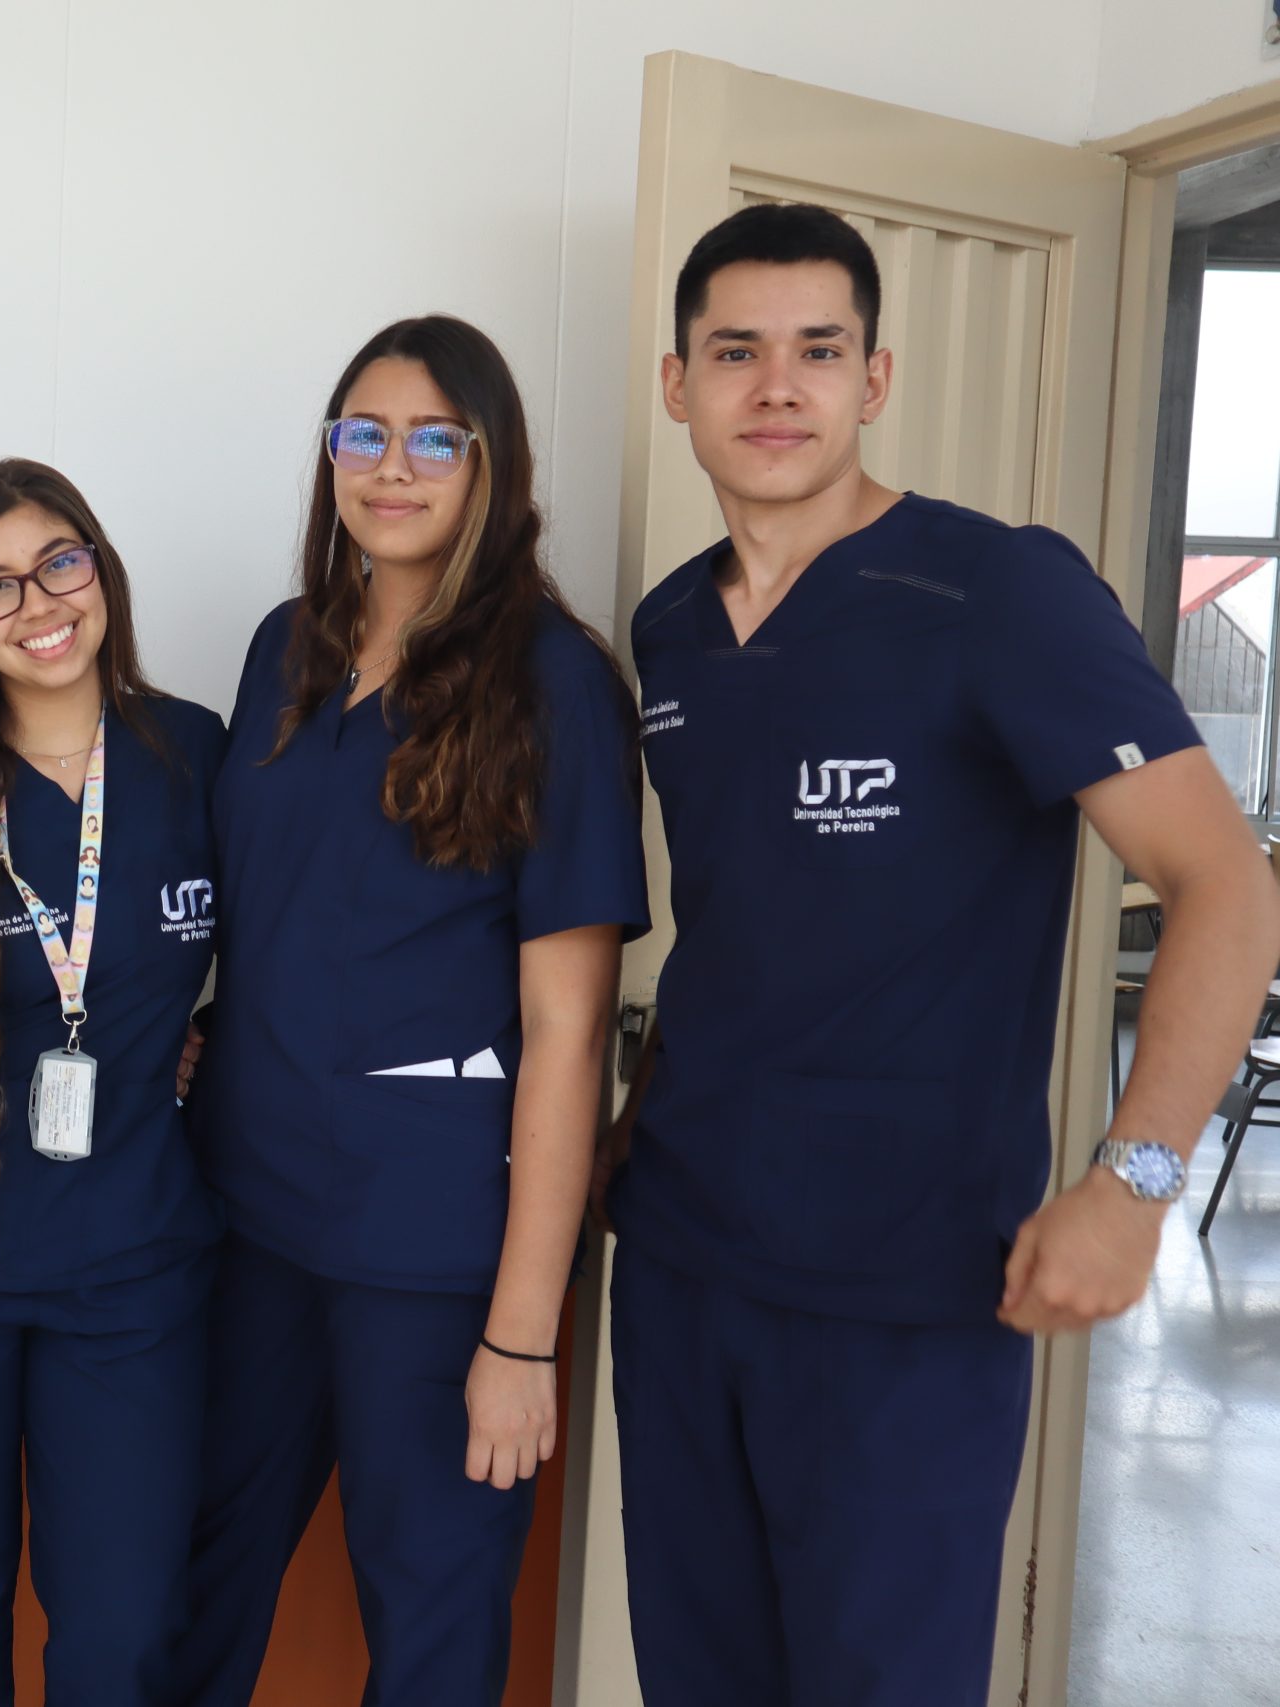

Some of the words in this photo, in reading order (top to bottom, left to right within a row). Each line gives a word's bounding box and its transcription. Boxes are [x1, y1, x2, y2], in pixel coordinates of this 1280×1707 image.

[798, 758, 896, 805] UTP
[794, 807, 843, 820] Universidad
[844, 804, 900, 819] Tecnológica
[818, 822, 831, 833] de
[833, 820, 875, 833] Pereira
[12, 915, 22, 924] de
[161, 920, 197, 932] Universidad
[3, 922, 34, 936] Ciencias
[181, 931, 190, 942] de
